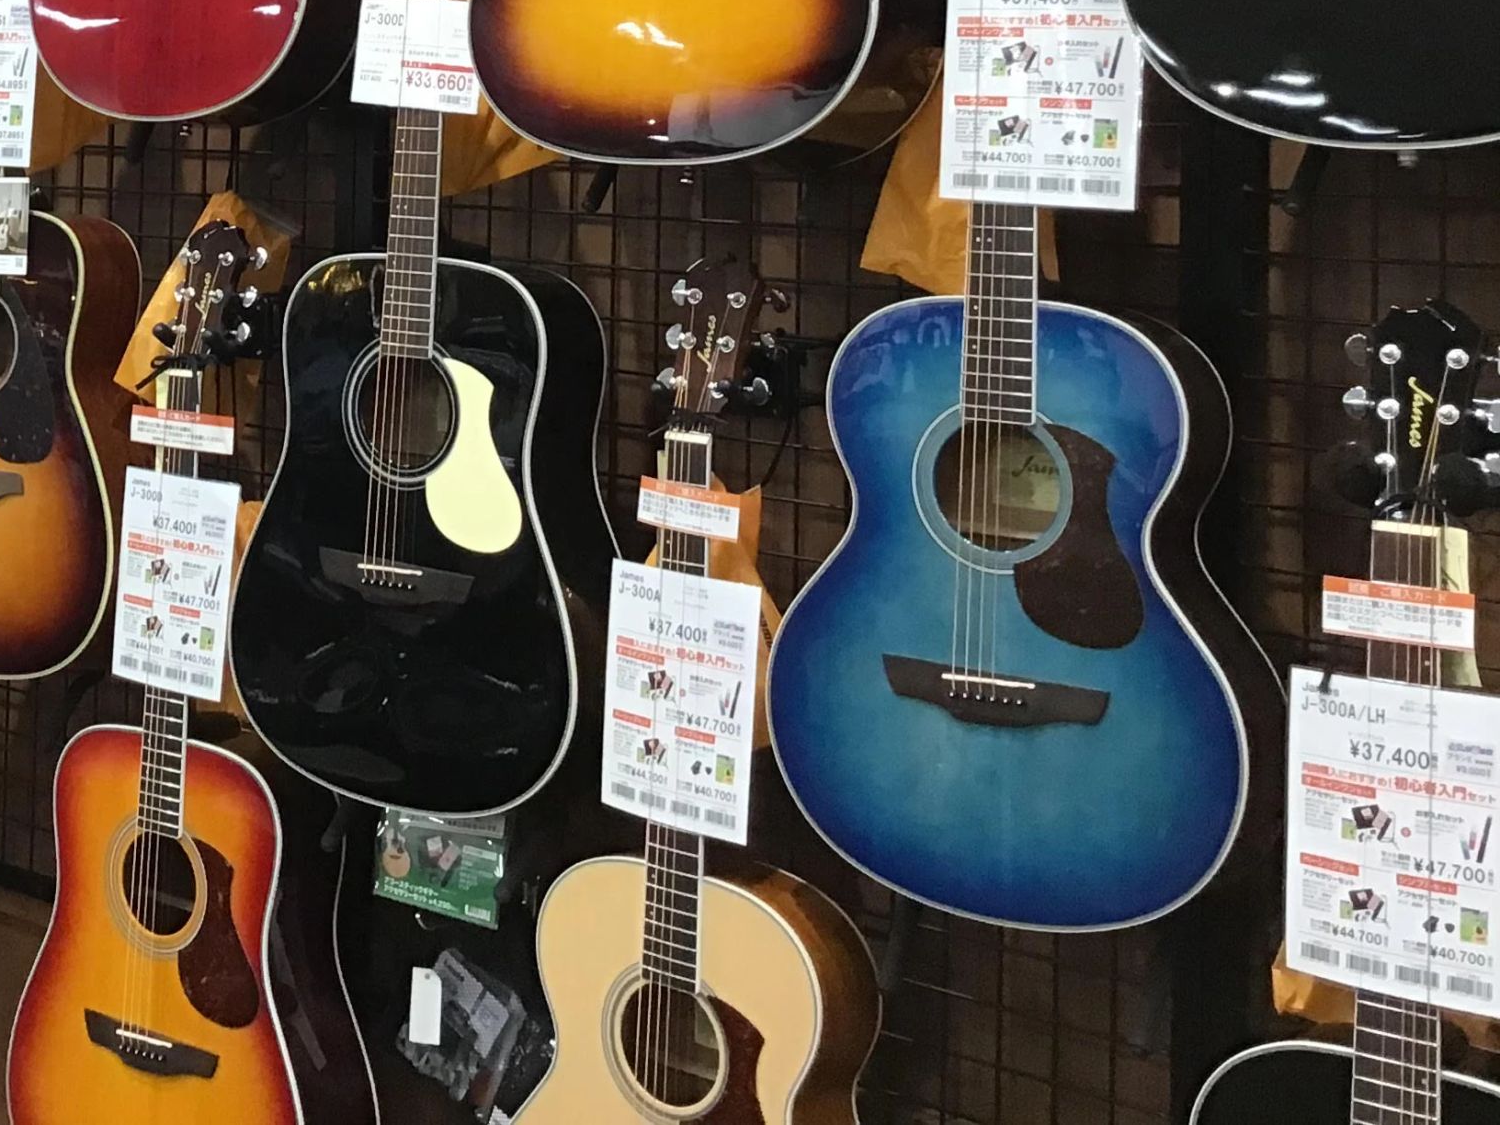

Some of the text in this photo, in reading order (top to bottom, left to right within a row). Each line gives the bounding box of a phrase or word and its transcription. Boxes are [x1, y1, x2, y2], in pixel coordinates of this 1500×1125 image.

[405, 70, 466, 92] ¥33,660
[1054, 82, 1117, 97] ¥47,700
[1407, 376, 1434, 448] James
[617, 581, 662, 603] J-300A
[1301, 679, 1340, 699] Jas
[1301, 695, 1387, 725] J-300A/LH
[1349, 737, 1431, 771] ¥37,400
[1413, 856, 1486, 884] ¥47,700
[1332, 924, 1382, 946] ¥44,700
[1428, 945, 1486, 967] ¥40,700
